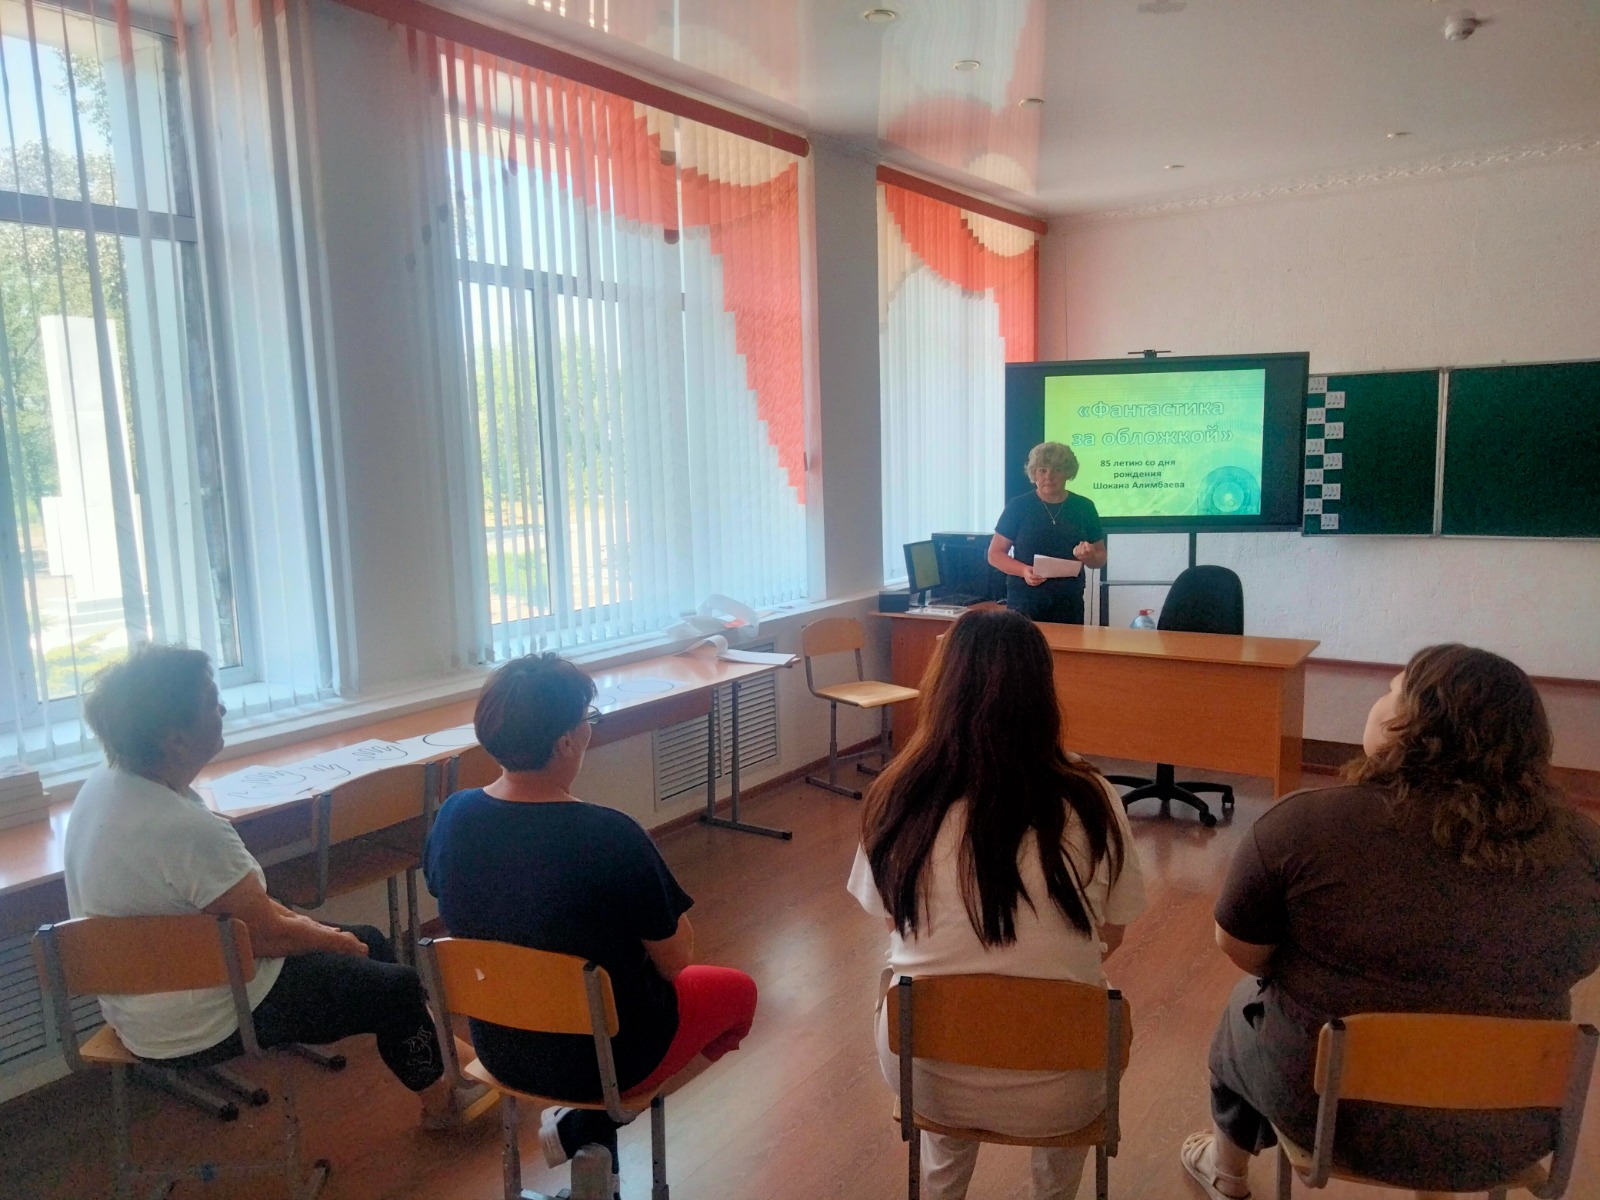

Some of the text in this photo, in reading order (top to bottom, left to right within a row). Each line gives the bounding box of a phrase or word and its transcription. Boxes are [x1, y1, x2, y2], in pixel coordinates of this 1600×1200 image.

[1078, 401, 1224, 418] «Фантастика
[1072, 425, 1233, 446] за обложкой»
[1114, 471, 1162, 479] рождения
[1092, 481, 1185, 490] Шокана Алимбаева
